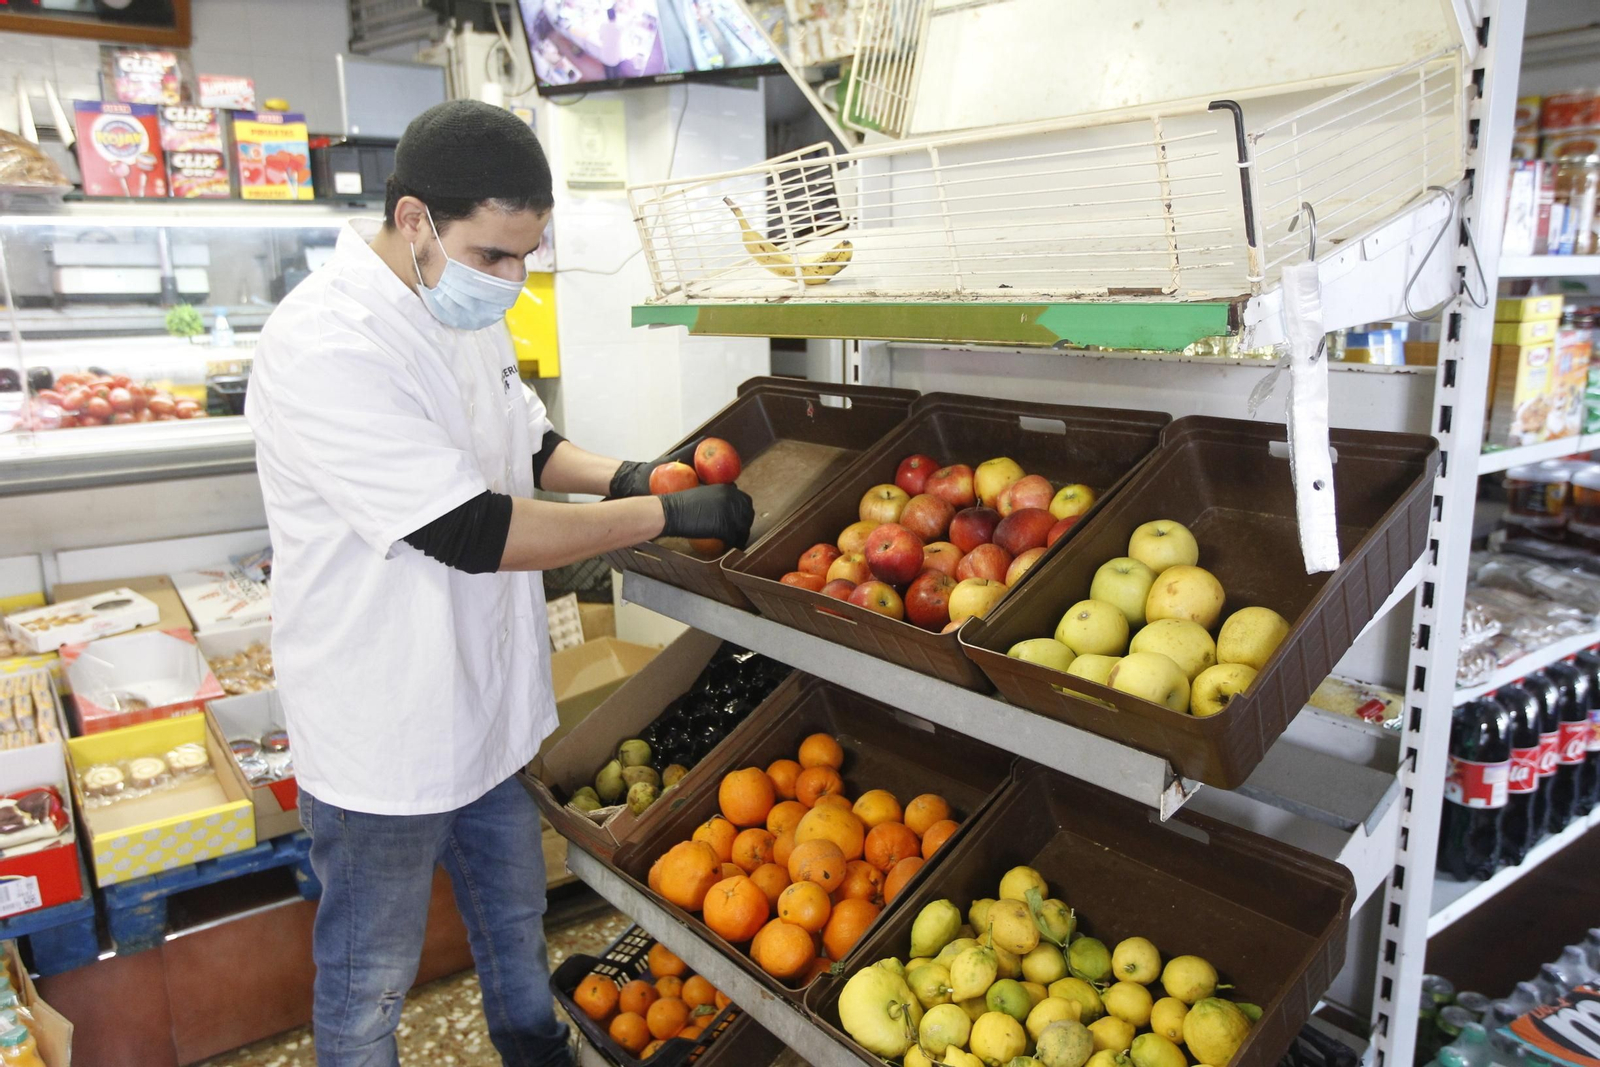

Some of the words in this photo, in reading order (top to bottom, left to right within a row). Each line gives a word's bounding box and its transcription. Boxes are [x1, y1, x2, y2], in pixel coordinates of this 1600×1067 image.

[165, 106, 212, 123] CLIX
[171, 152, 219, 170] CLIX
[181, 167, 215, 178] ONE
